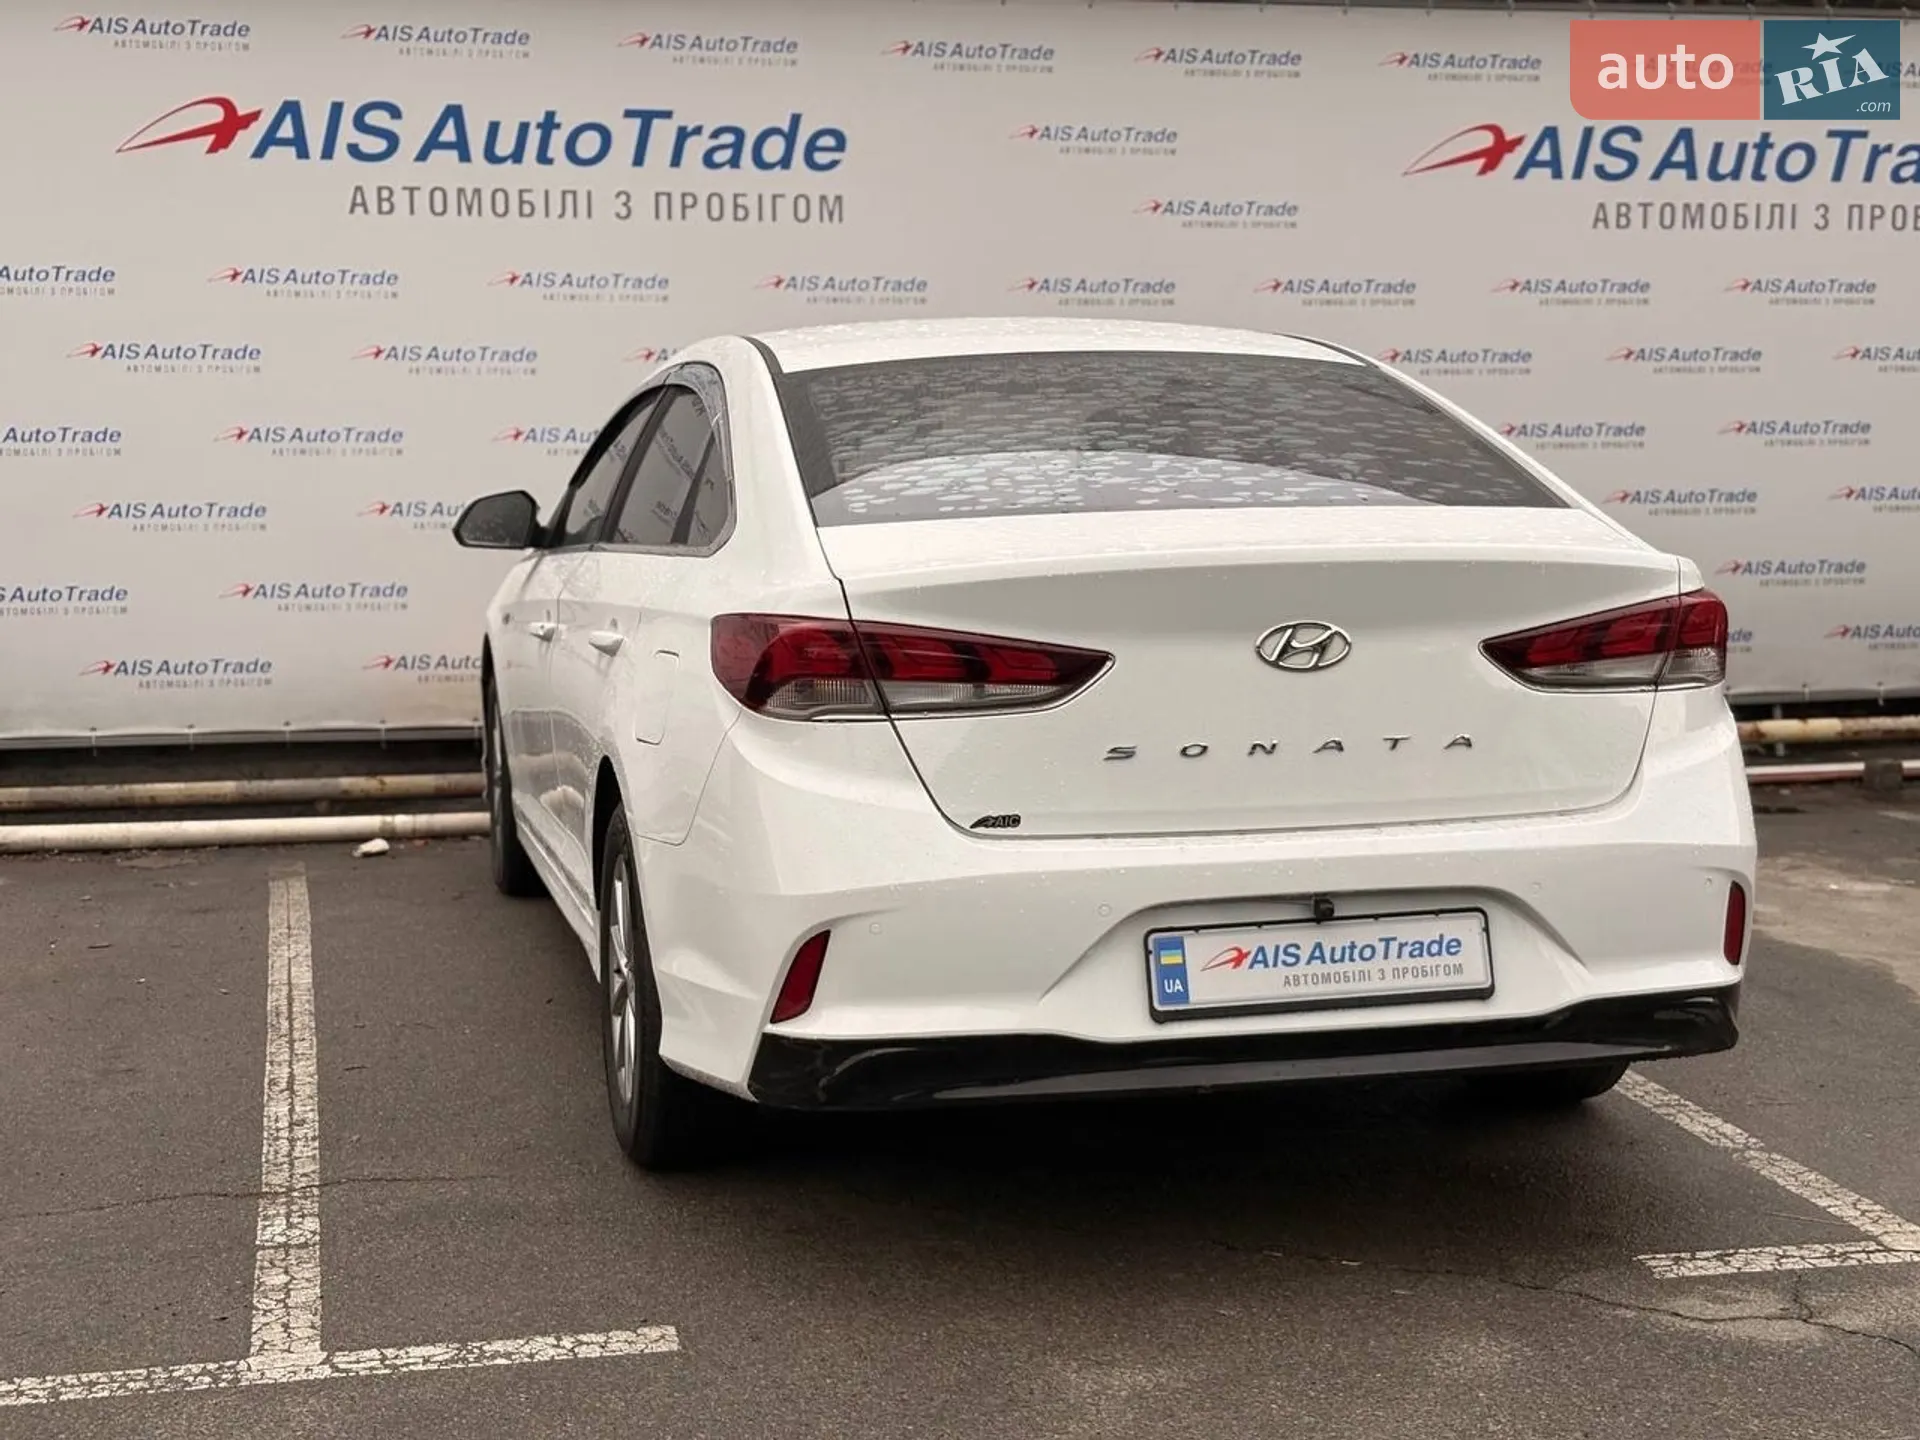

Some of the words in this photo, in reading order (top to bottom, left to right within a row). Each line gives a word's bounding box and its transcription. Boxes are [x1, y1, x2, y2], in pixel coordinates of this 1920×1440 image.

[88, 16, 129, 35] AIS
[131, 17, 252, 38] AutoTrade
[374, 24, 414, 42] AIS
[416, 26, 531, 46] AutoTrade
[648, 33, 687, 50] AIS
[689, 34, 799, 55] AutoTrade
[910, 40, 947, 58] AIS
[949, 42, 1055, 62] AutoTrade
[1162, 47, 1198, 64] AIS
[1200, 48, 1303, 67] AutoTrade
[1408, 52, 1442, 68] AIS
[1444, 53, 1542, 71] AutoTrade
[250, 100, 403, 163] AIS
[413, 104, 848, 173] AutoTrade
[1038, 125, 1074, 141] AIS
[1076, 126, 1178, 144] AutoTrade
[1513, 125, 1643, 182] AIS
[348, 185, 593, 219] АВТОМОБІЛІ
[614, 190, 632, 221] З
[654, 191, 844, 224] ПРОБІГОМ
[1162, 200, 1197, 216] AIS
[1199, 200, 1299, 217] AutoTrade
[1592, 201, 1797, 231] АВТОМОБІЛІ
[1813, 203, 1830, 231] З
[0, 265, 116, 283] AutoTrade
[241, 268, 281, 284] AIS
[283, 268, 400, 286] AutoTrade
[520, 272, 558, 288] AIS
[560, 272, 670, 290] AutoTrade
[784, 275, 821, 291] AIS
[823, 276, 928, 293] AutoTrade
[1038, 278, 1073, 293] AIS
[1074, 278, 1176, 294] AutoTrade
[1282, 278, 1316, 294] AIS
[1318, 279, 1417, 295] AutoTrade
[1519, 279, 1553, 294] AIS
[1554, 279, 1651, 294] AutoTrade
[1751, 278, 1784, 293] AIS
[1785, 278, 1878, 294] AutoTrade
[101, 343, 142, 360] AIS
[144, 344, 262, 361] AutoTrade
[384, 345, 424, 361] AIS
[426, 346, 539, 363] AutoTrade
[1400, 348, 1434, 364] AIS
[1436, 348, 1533, 364] AutoTrade
[1634, 347, 1667, 362] AIS
[1669, 347, 1763, 362] AutoTrade
[1860, 346, 1892, 361] AIS
[2, 427, 122, 443] AutoTrade
[248, 427, 287, 443] AIS
[289, 427, 404, 443] AutoTrade
[524, 427, 560, 443] AIS
[1516, 423, 1549, 438] AIS
[1551, 422, 1646, 438] AutoTrade
[1746, 420, 1779, 435] AIS
[1780, 420, 1872, 435] AutoTrade
[1630, 489, 1662, 505] AIS
[1664, 488, 1758, 504] AutoTrade
[1854, 486, 1886, 501] AIS
[108, 503, 148, 519] AIS
[150, 502, 268, 519] AutoTrade
[390, 502, 428, 516] AIS
[1741, 560, 1773, 576] AIS
[1775, 559, 1867, 575] AutoTrade
[10, 585, 129, 603] AutoTrade
[252, 583, 292, 600] AIS
[294, 582, 409, 599] AutoTrade
[1850, 624, 1880, 639] AIS
[114, 660, 154, 677] AIS
[156, 657, 273, 676] AutoTrade
[394, 654, 432, 670] AIS
[1102, 735, 1474, 763] SONATA
[1248, 943, 1302, 970] AIS
[1305, 934, 1462, 967] AutoTrade
[1283, 969, 1372, 988] АВТОМОБІЛІ
[1377, 969, 1386, 981] З
[1392, 963, 1464, 981] ПРОБІГОМ
[1164, 979, 1184, 993] UA
